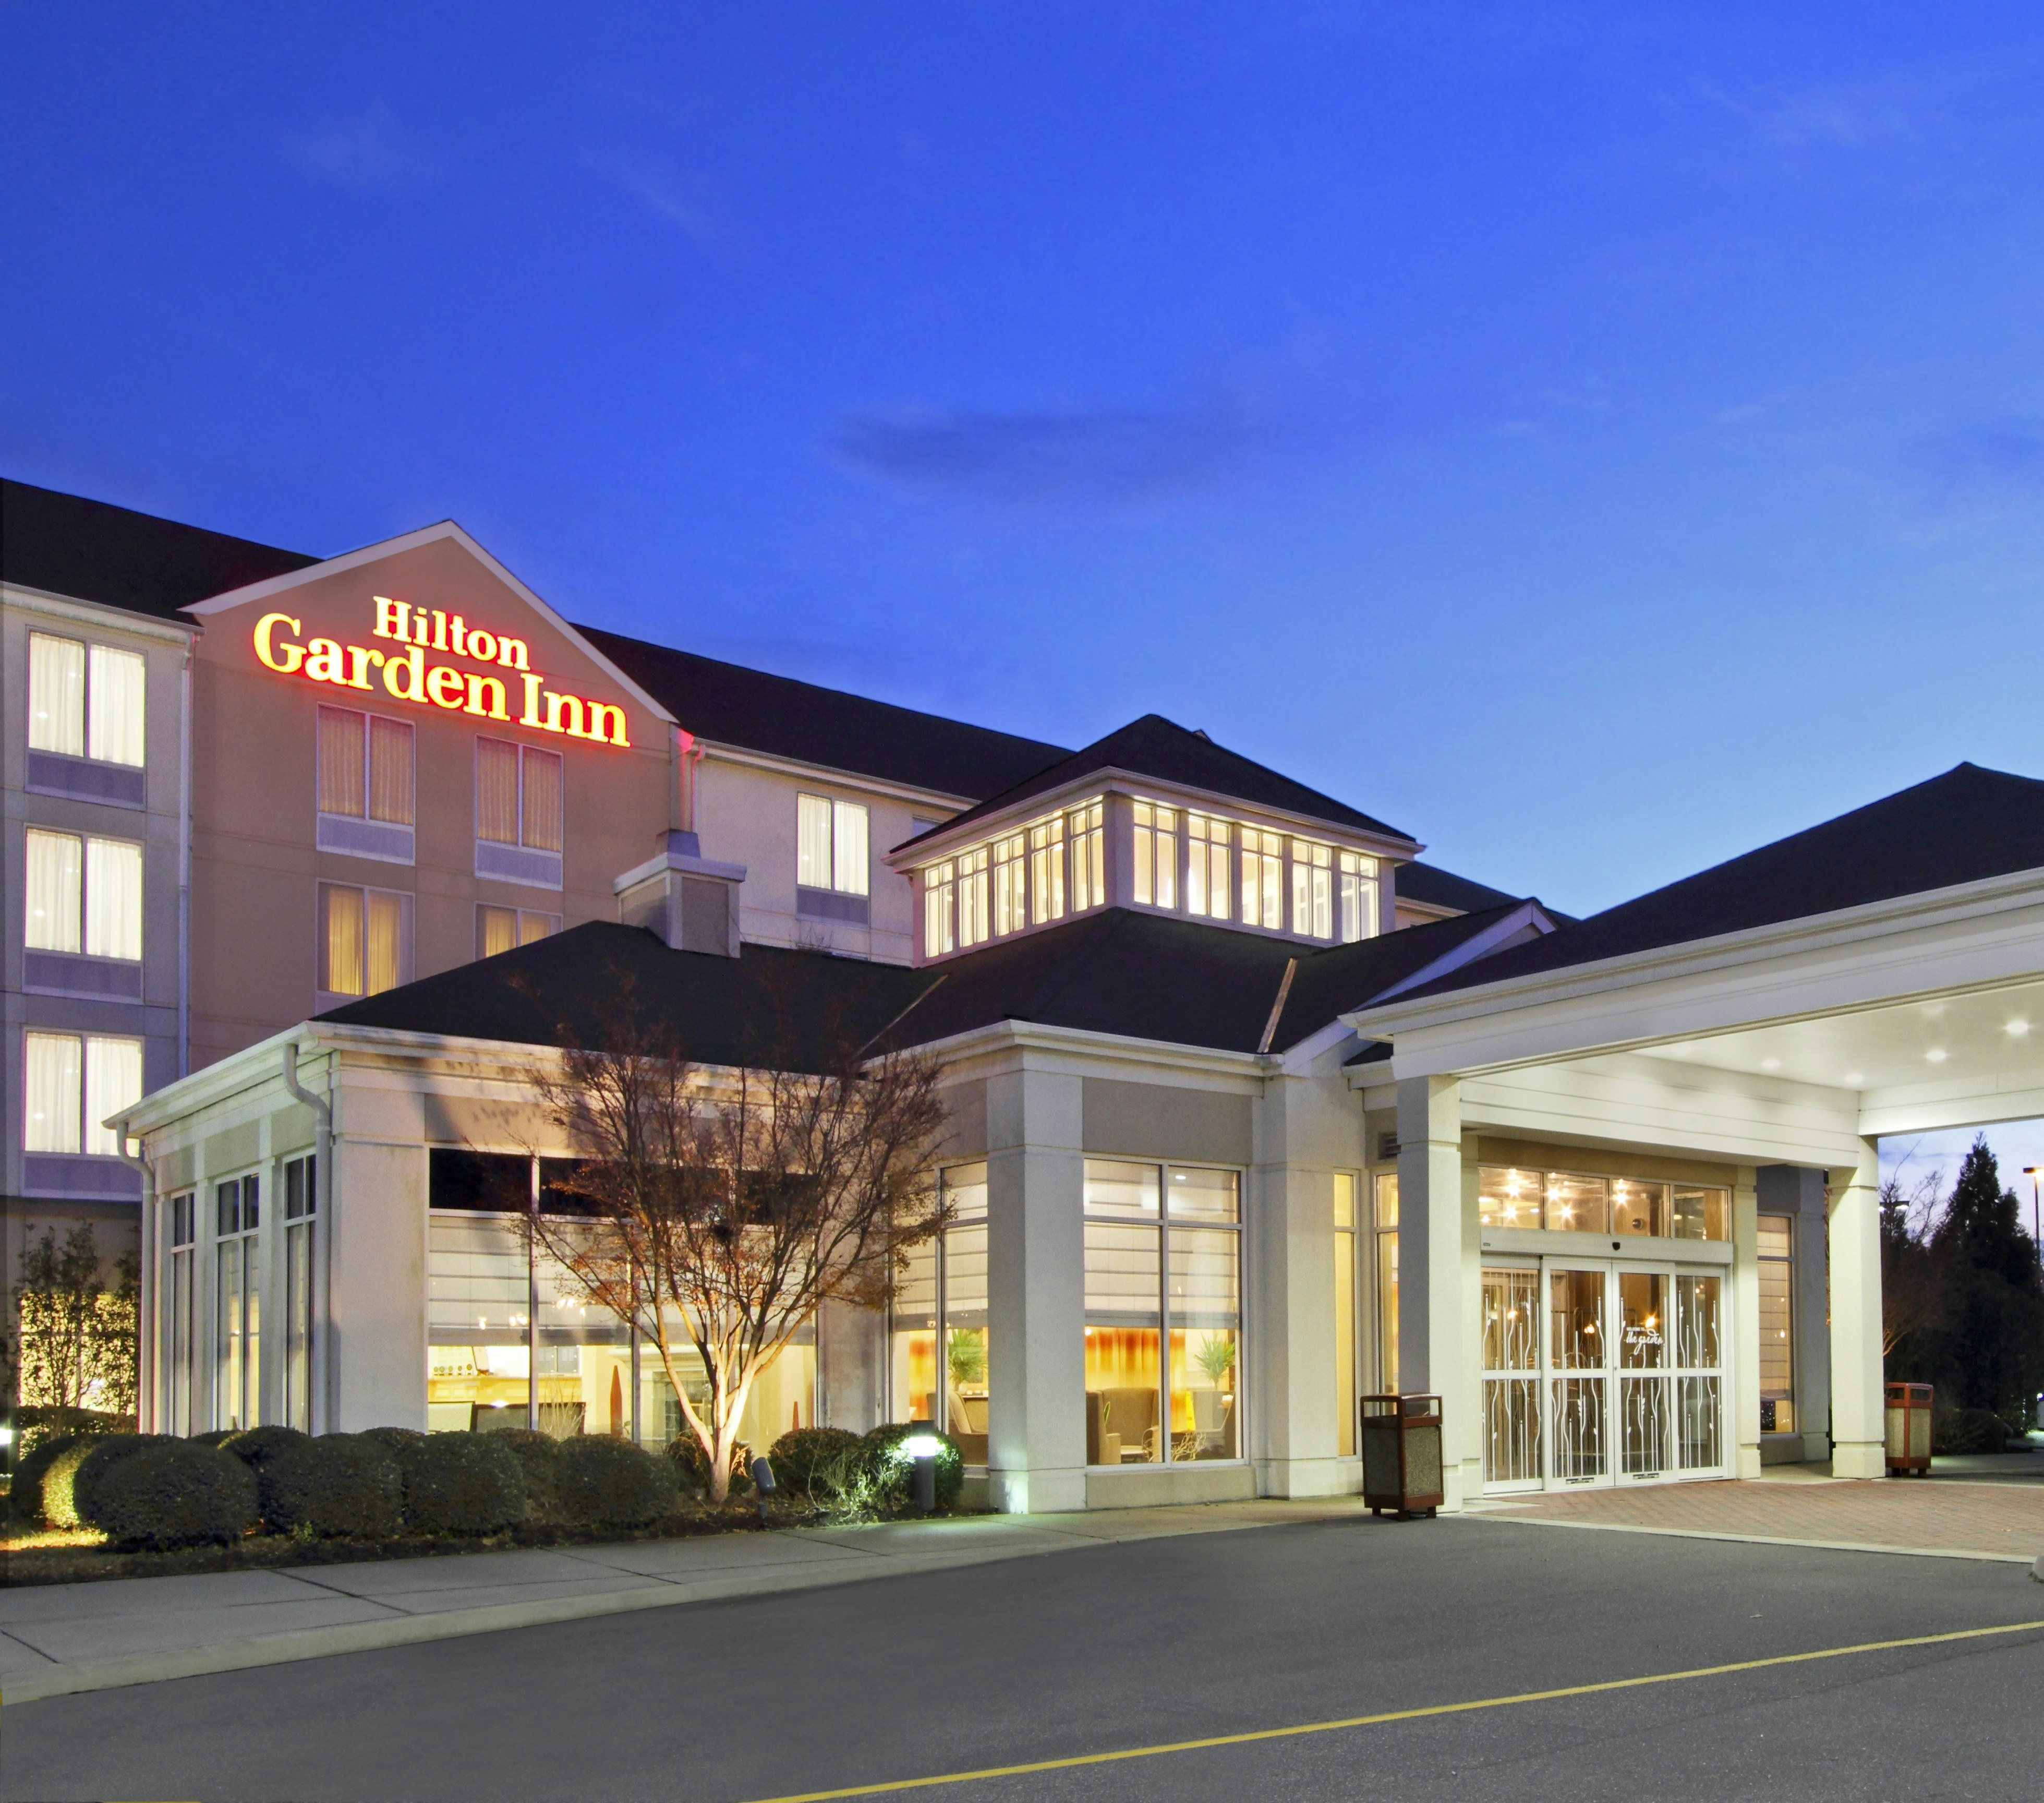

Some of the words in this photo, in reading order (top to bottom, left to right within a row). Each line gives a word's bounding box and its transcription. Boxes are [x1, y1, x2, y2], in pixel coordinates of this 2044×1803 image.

[253, 612, 511, 722] Garden
[519, 672, 631, 748] Inn
[372, 595, 531, 671] Hilton
